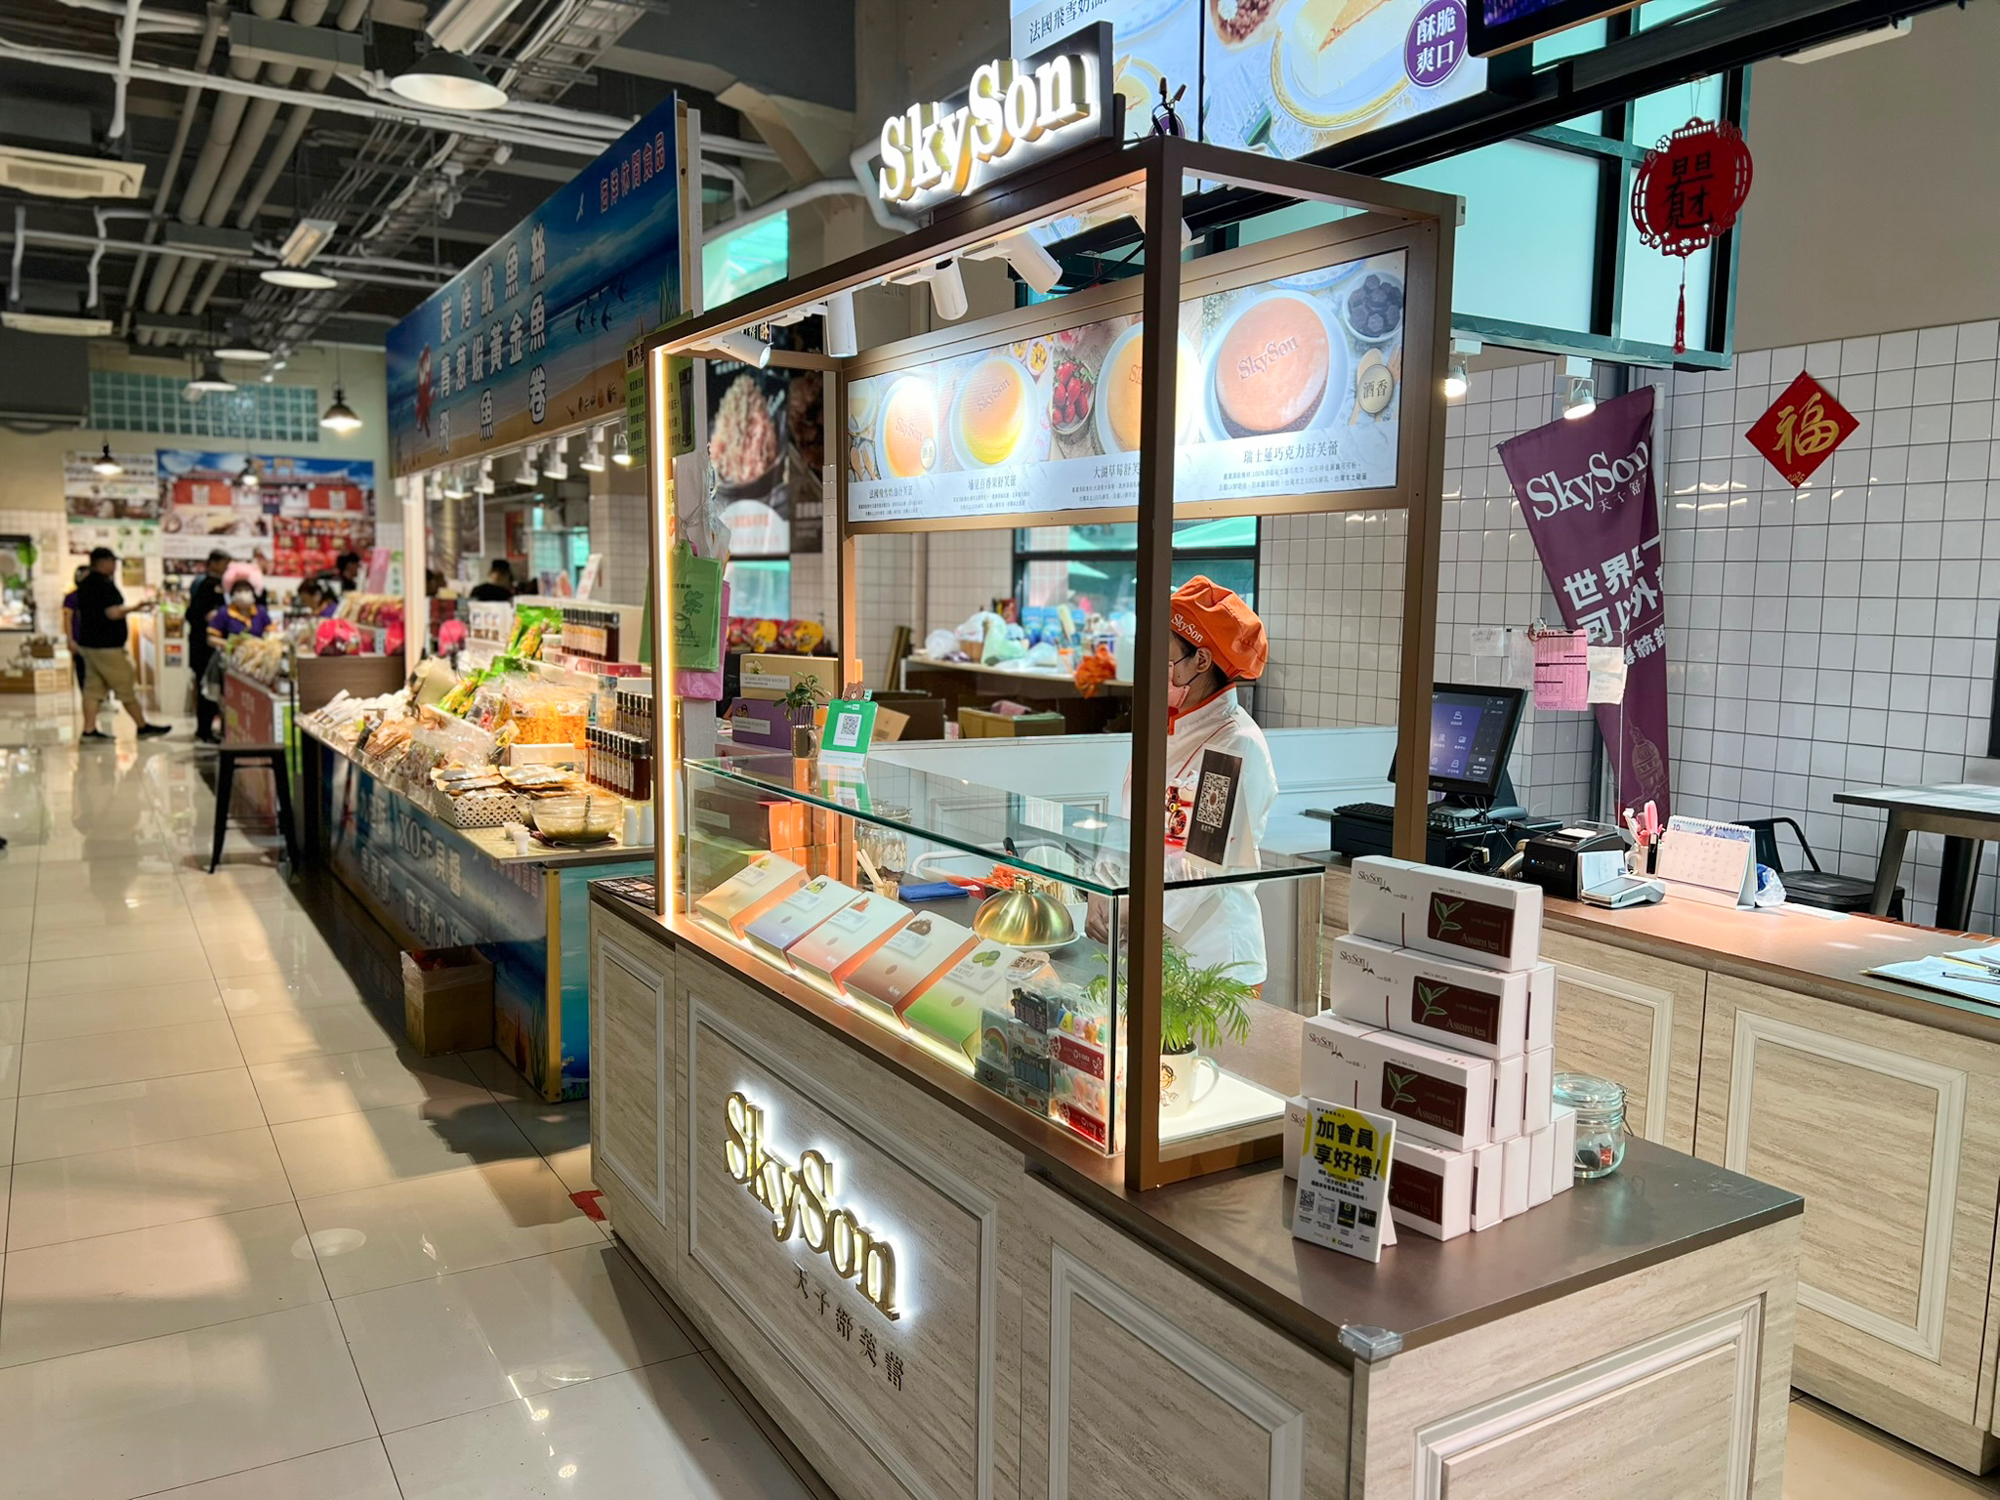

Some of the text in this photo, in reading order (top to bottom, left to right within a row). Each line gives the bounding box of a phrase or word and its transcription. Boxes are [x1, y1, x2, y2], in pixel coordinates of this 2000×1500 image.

[1416, 6, 1457, 46] 酥脆
[1415, 40, 1455, 78] 爽口
[879, 54, 1093, 203] SkySon
[1238, 336, 1299, 381] SkySon
[976, 378, 1011, 412] SkySon
[1362, 379, 1388, 399] 酒香
[1772, 391, 1839, 465] 福
[1243, 440, 1339, 464] 瑞士蓮巧克力舒芙蕾
[1526, 441, 1649, 521] SkySon
[1171, 613, 1203, 643] SkySon
[1358, 870, 1383, 885] SkySon
[1339, 950, 1365, 966] SkySon
[1461, 932, 1499, 950] Assam tea
[1308, 1033, 1334, 1048] SkySon
[1446, 1018, 1486, 1037] Assam tea
[1316, 1116, 1374, 1151] 加會員
[1415, 1106, 1454, 1128] Assam tea
[1314, 1143, 1381, 1181] 享好禮!
[724, 1092, 900, 1321] SkySon
[793, 1261, 904, 1391] 天子舒芙蕾
